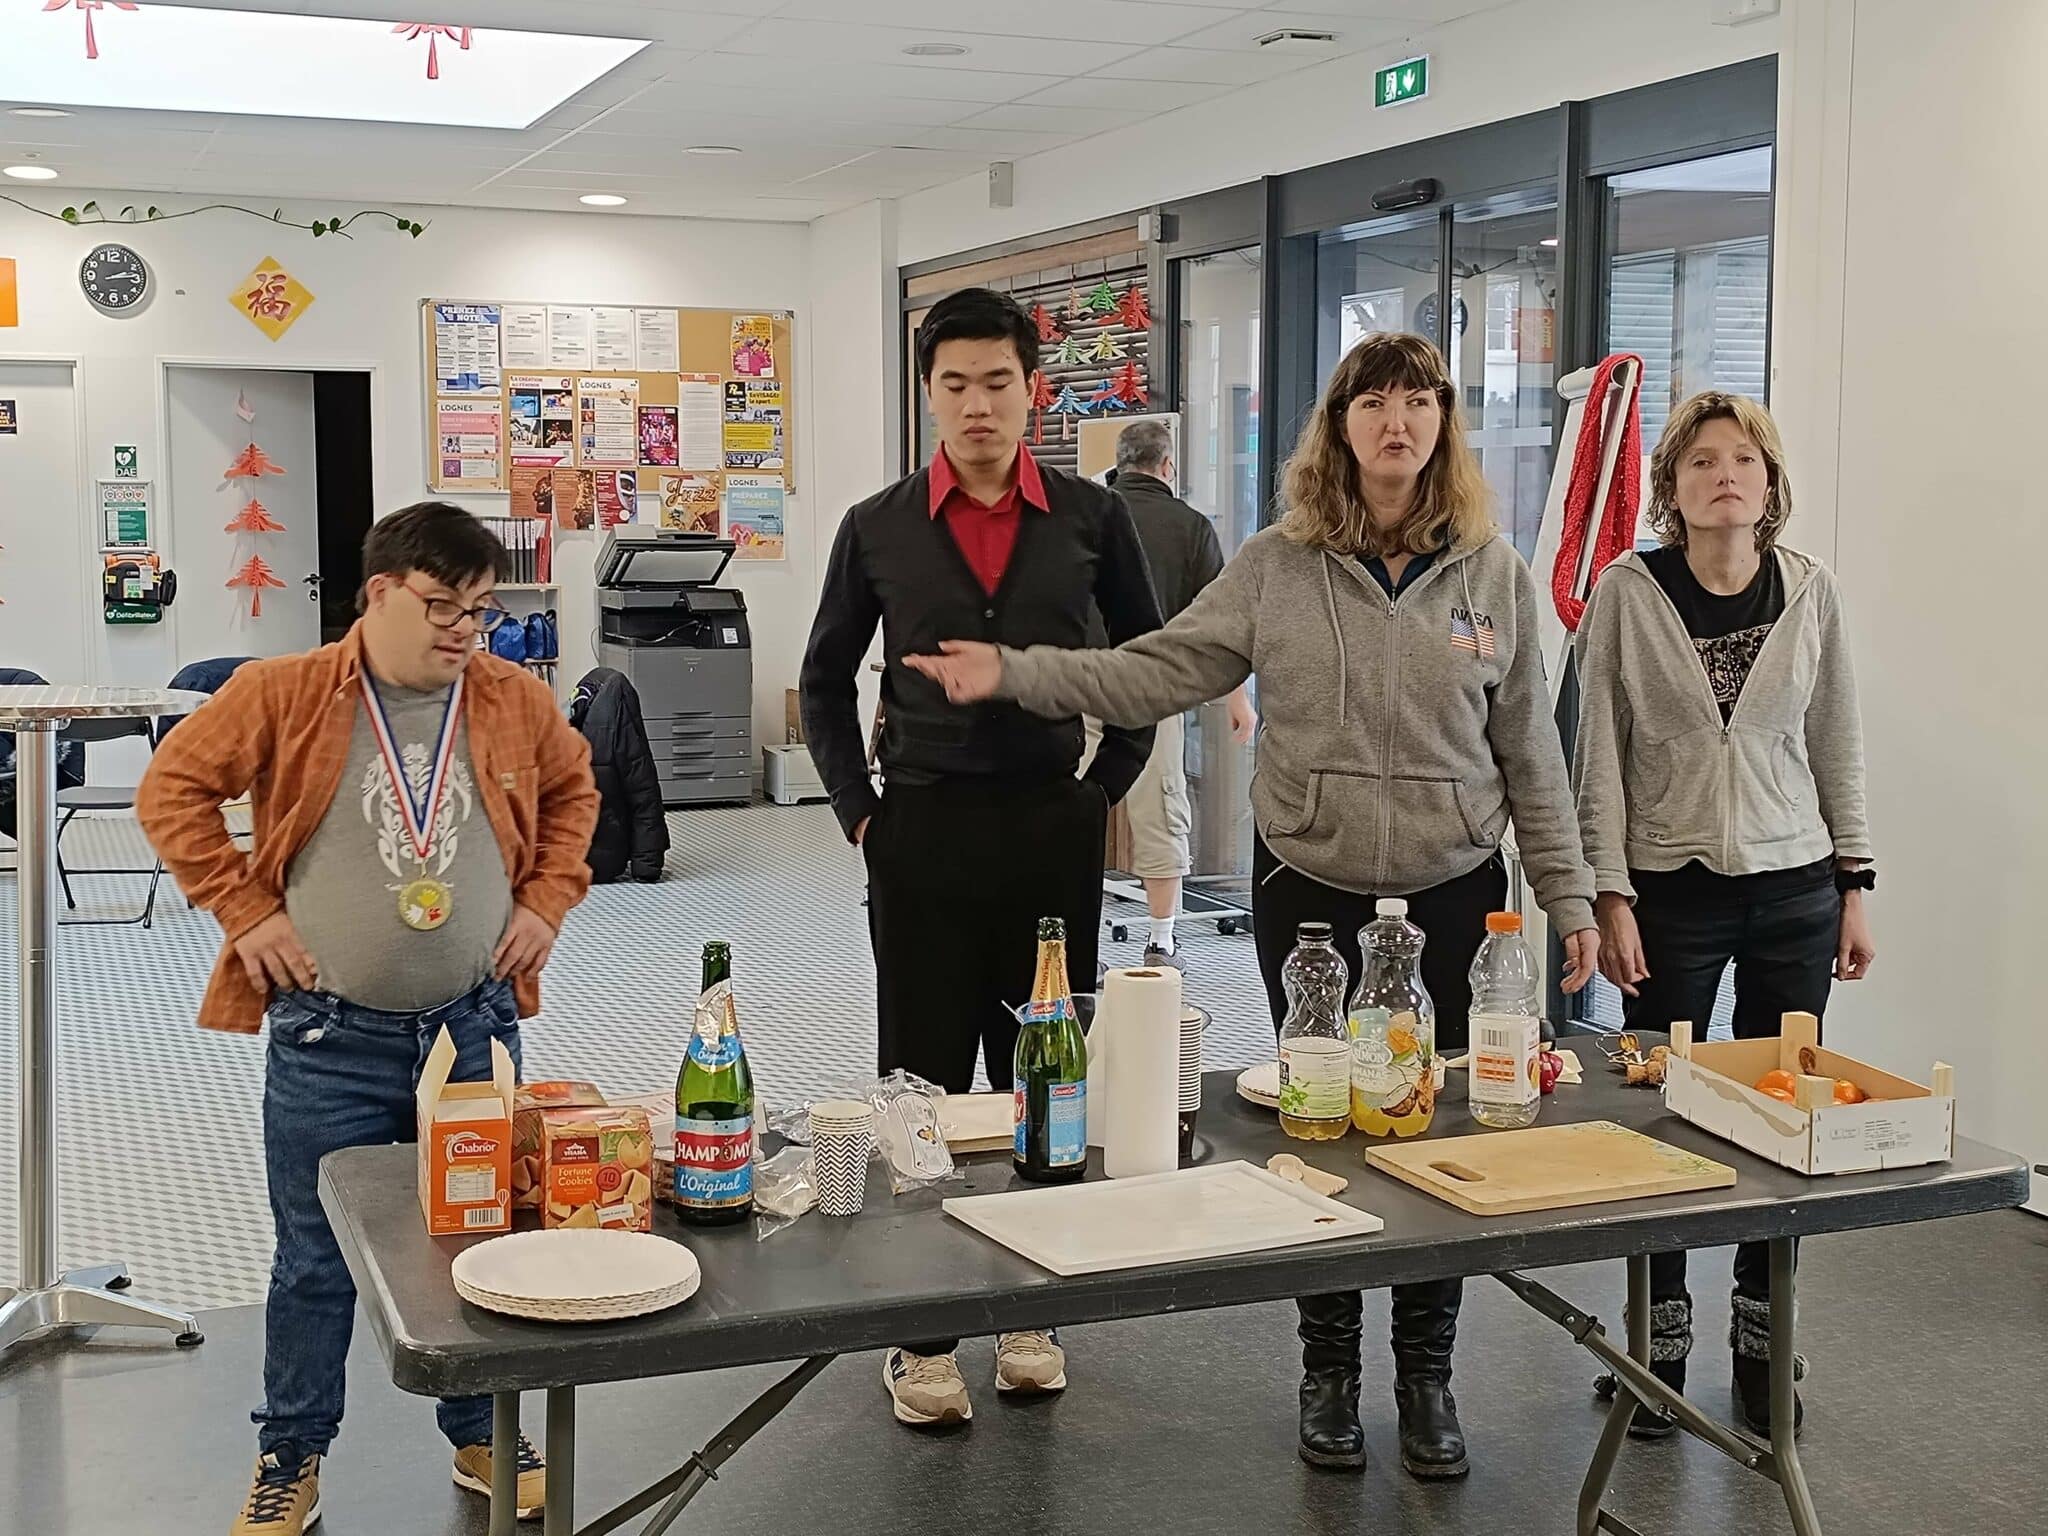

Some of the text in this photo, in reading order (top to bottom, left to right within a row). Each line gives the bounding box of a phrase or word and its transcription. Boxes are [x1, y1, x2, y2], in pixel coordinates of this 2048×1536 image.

[107, 251, 120, 262] 12
[87, 270, 96, 280] 9
[130, 273, 140, 283] 3
[99, 293, 104, 301] 7
[109, 292, 118, 303] 6
[247, 274, 291, 322] 福
[116, 468, 136, 477] DAE
[1451, 608, 1493, 629] NASA
[558, 1168, 593, 1176] Fortune
[603, 1172, 616, 1182] 10
[558, 1176, 593, 1186] Cookies
[680, 1173, 740, 1199] L'Original
